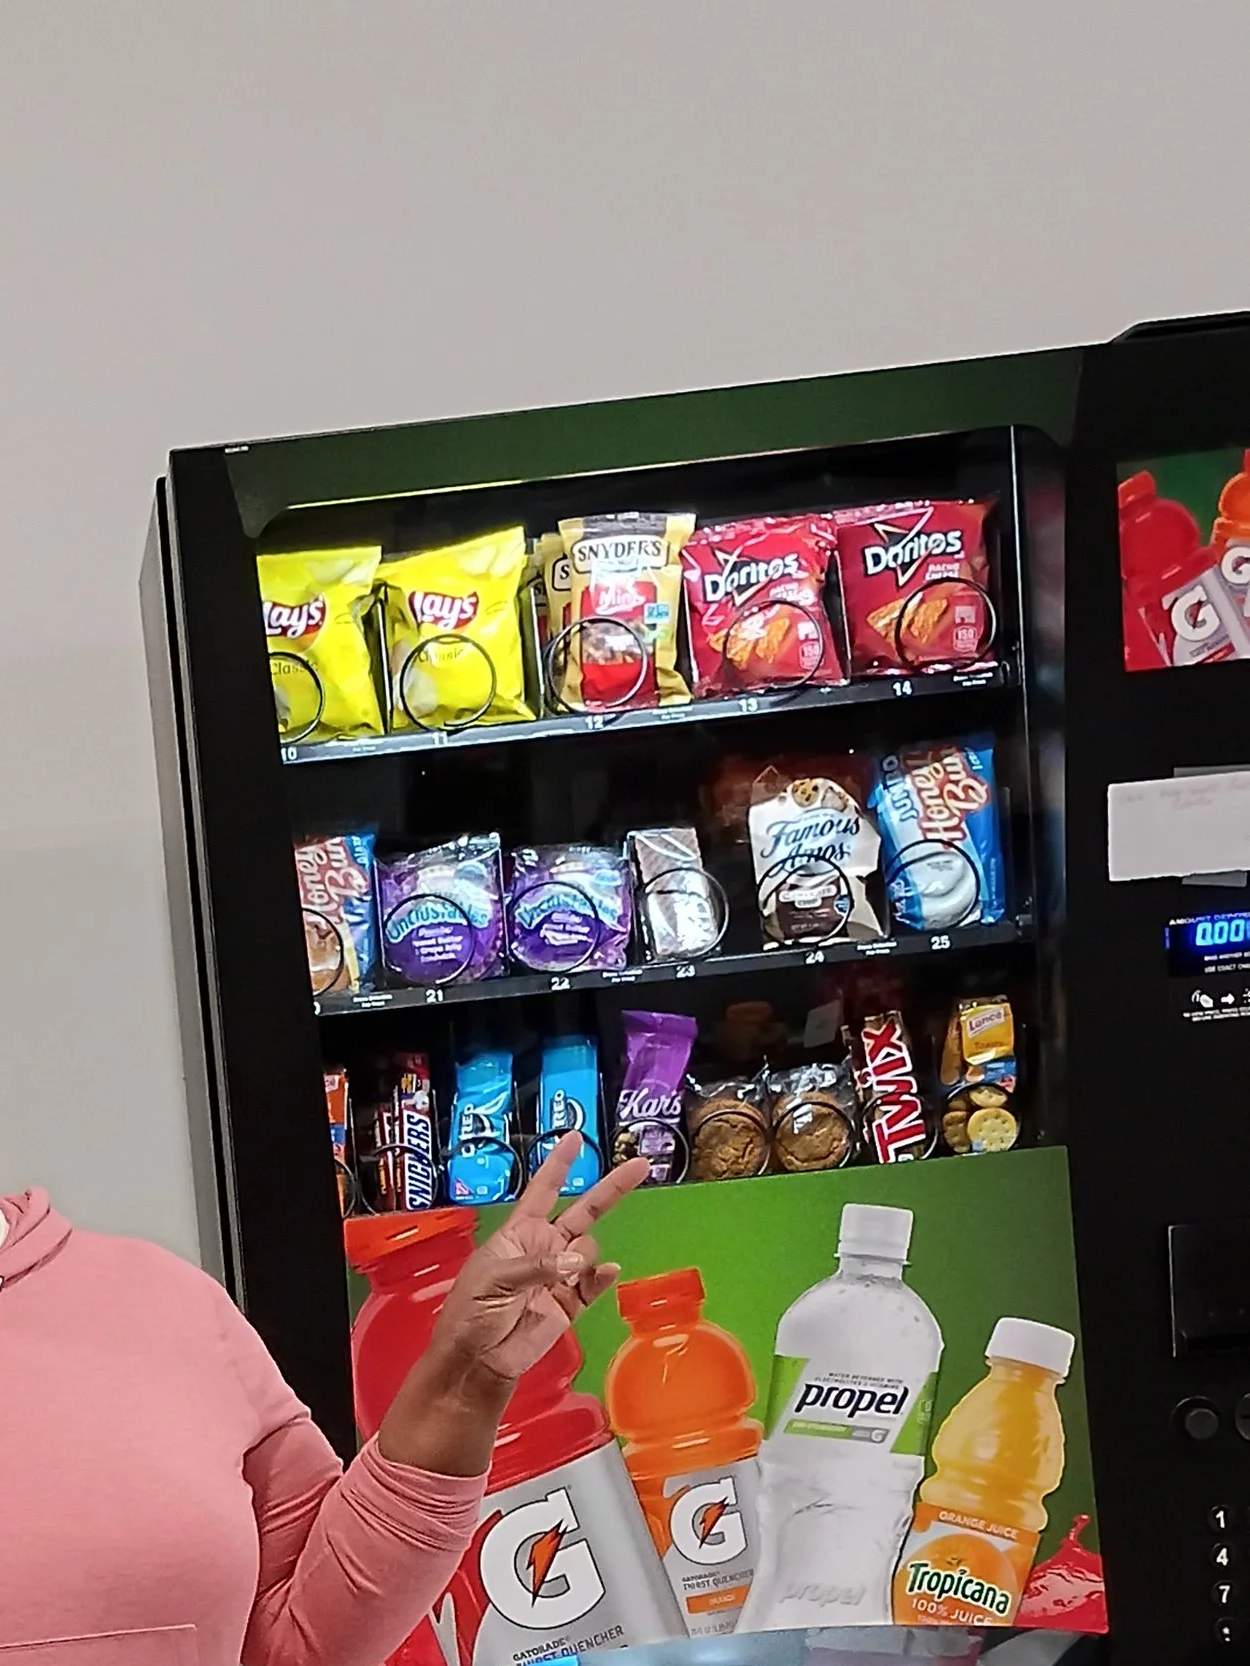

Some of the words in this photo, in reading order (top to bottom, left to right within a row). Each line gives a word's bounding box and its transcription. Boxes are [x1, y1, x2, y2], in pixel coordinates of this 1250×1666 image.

[864, 529, 962, 576] Doritos
[703, 553, 800, 603] Doritos
[892, 680, 914, 697] 14
[738, 699, 758, 712] 13
[760, 815, 861, 858] Famous
[930, 937, 951, 951] 25
[805, 951, 824, 965] 24
[676, 965, 695, 979] 23
[551, 977, 571, 991] 22
[425, 989, 444, 1003] 21
[862, 1018, 927, 1165] TWIX
[619, 1087, 682, 1120] Kar's
[794, 1384, 909, 1418] propel
[670, 1477, 748, 1565] G
[938, 1510, 986, 1530] ORANGE
[986, 1524, 1019, 1540] JUICE
[1215, 1511, 1226, 1529] 1
[479, 1488, 606, 1630] G
[1216, 1548, 1229, 1566] 4
[908, 1562, 1011, 1615] Tropicana
[1219, 1585, 1230, 1603] 7
[912, 1598, 948, 1617] 100%
